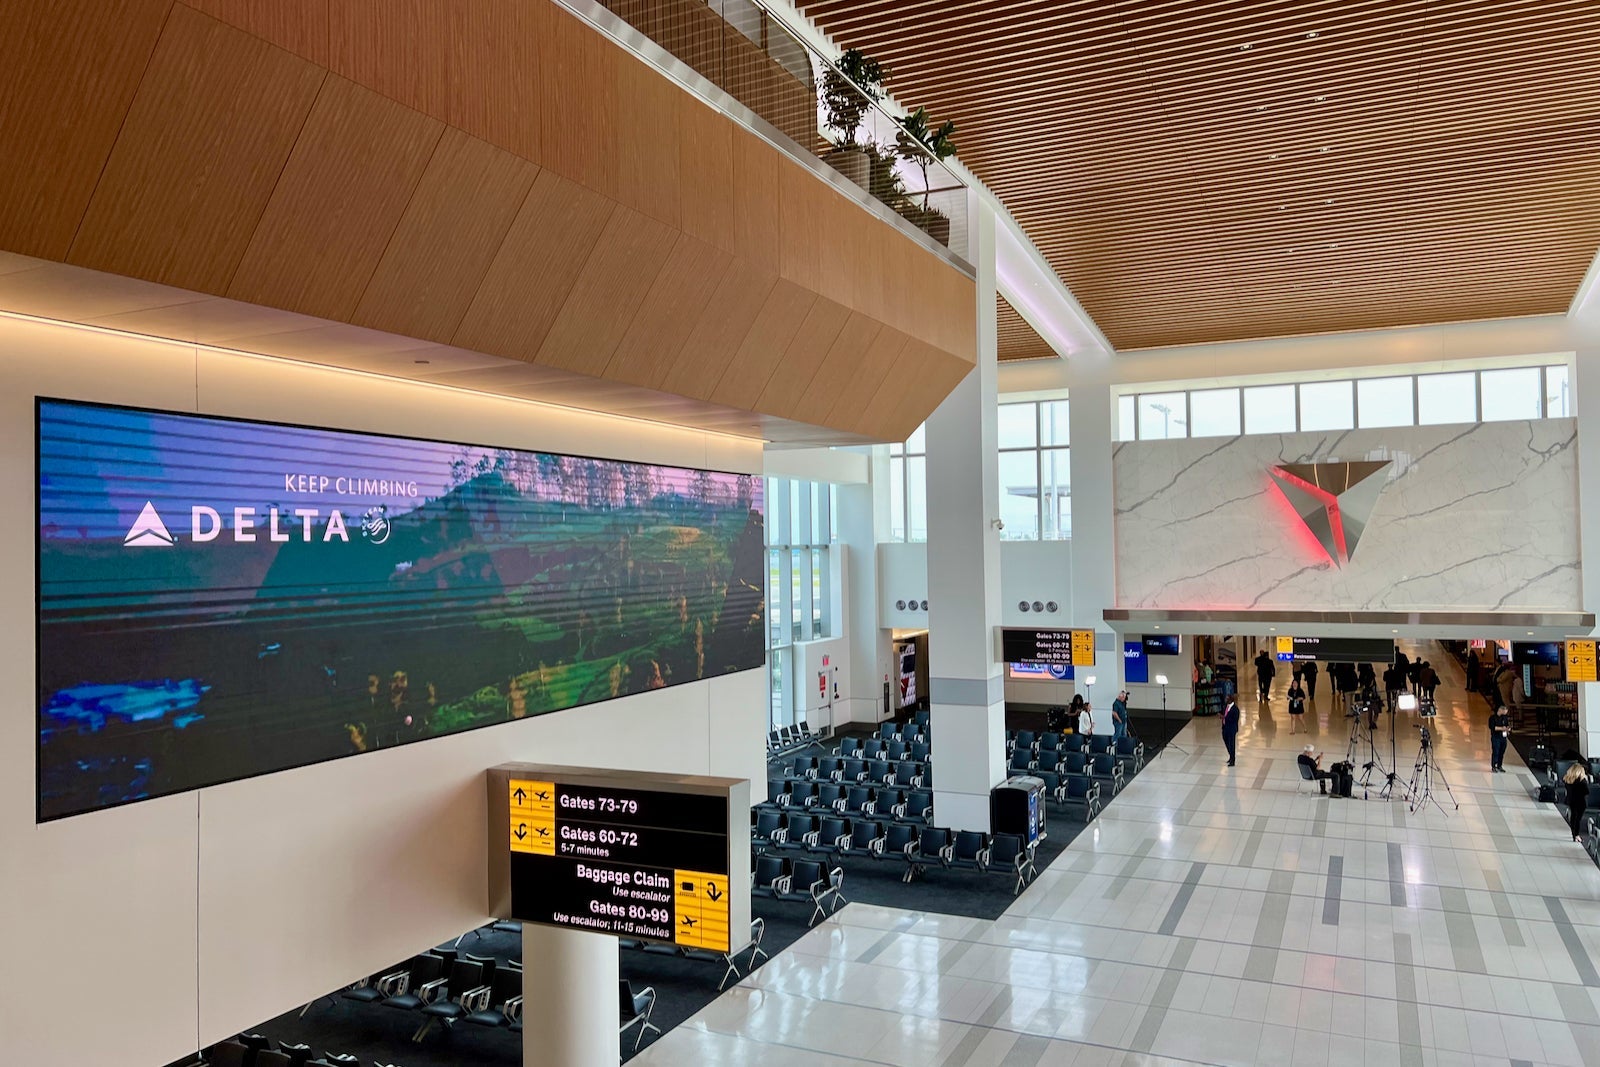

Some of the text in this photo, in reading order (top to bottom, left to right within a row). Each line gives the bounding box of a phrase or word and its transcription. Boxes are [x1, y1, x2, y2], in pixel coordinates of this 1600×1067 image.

[285, 473, 418, 497] KEEP CLIMBING
[191, 505, 350, 542] DELTA
[560, 794, 638, 814] Gates 73-79
[560, 826, 638, 847] Gates 60-72
[560, 842, 610, 858] 5-7 minutes
[577, 863, 670, 888] Baggage Claim
[612, 885, 671, 903] Use escalator
[589, 900, 669, 923] Gates 80-99
[553, 912, 670, 938] Use escalator; 11-15 minutes
